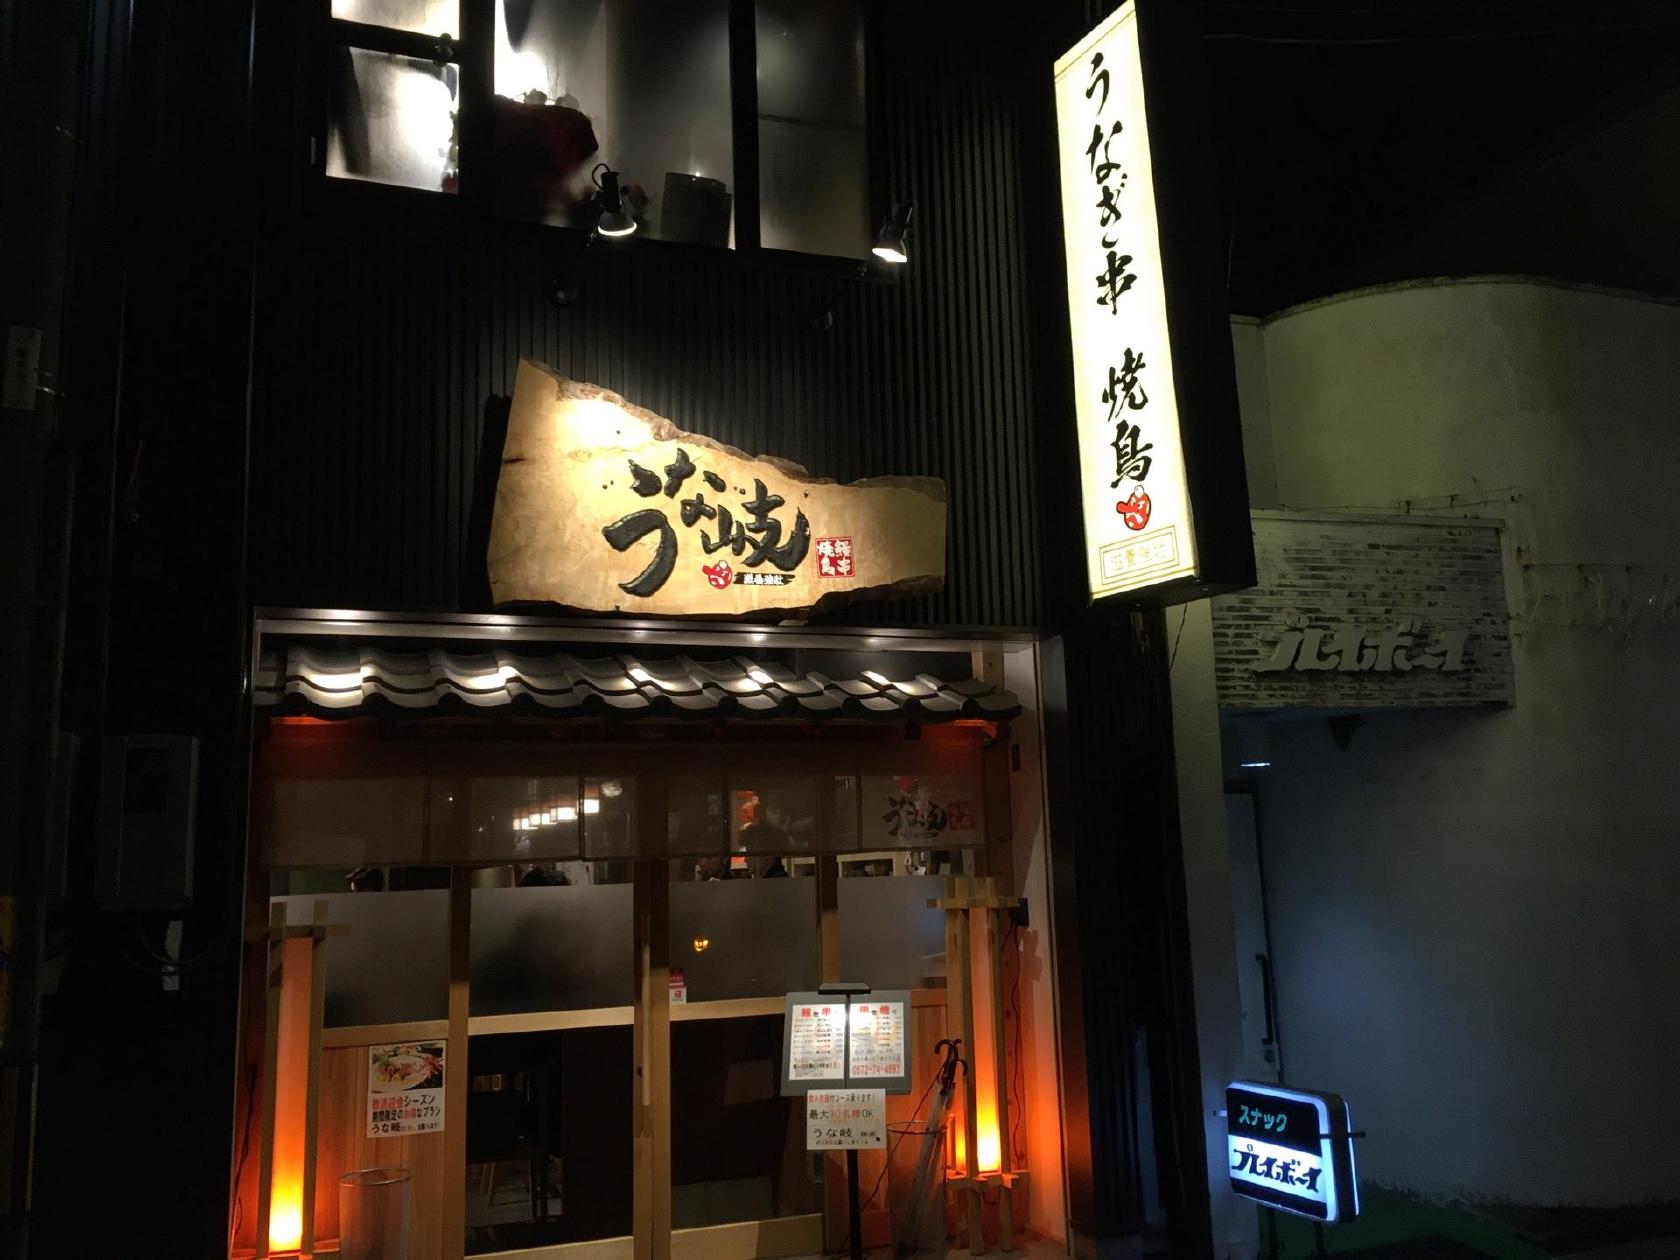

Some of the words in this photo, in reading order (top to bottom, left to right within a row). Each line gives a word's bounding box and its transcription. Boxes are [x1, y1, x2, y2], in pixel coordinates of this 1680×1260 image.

[1085, 52, 1138, 316] うなぎ串
[1102, 347, 1154, 489] 焼鳥
[602, 447, 812, 598] うな岐
[1231, 1143, 1323, 1194] プレイボーイ
[1238, 1104, 1288, 1132] スナック
